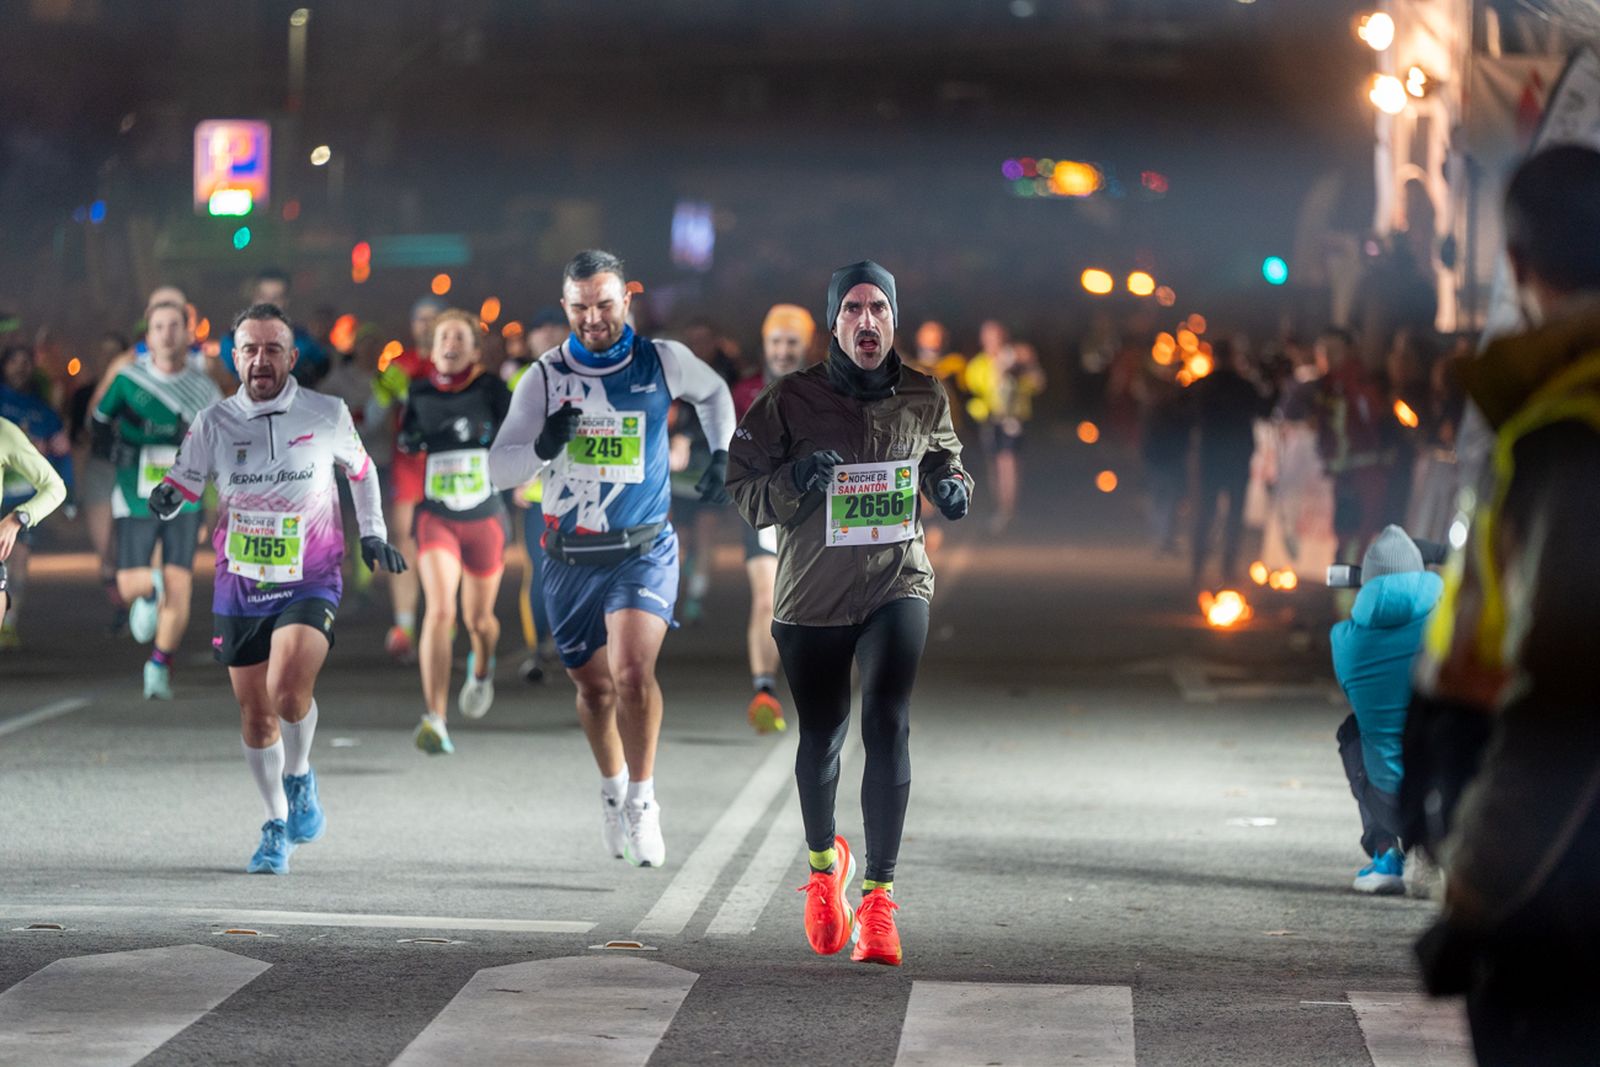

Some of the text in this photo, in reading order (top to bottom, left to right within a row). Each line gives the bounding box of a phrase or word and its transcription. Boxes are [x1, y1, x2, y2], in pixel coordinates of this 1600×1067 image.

[585, 437, 622, 458] 245
[273, 469, 313, 485] SEGURA
[848, 473, 888, 483] NOCHE DE
[838, 485, 856, 495] SAN
[845, 492, 904, 519] 2656
[243, 535, 286, 558] 7155
